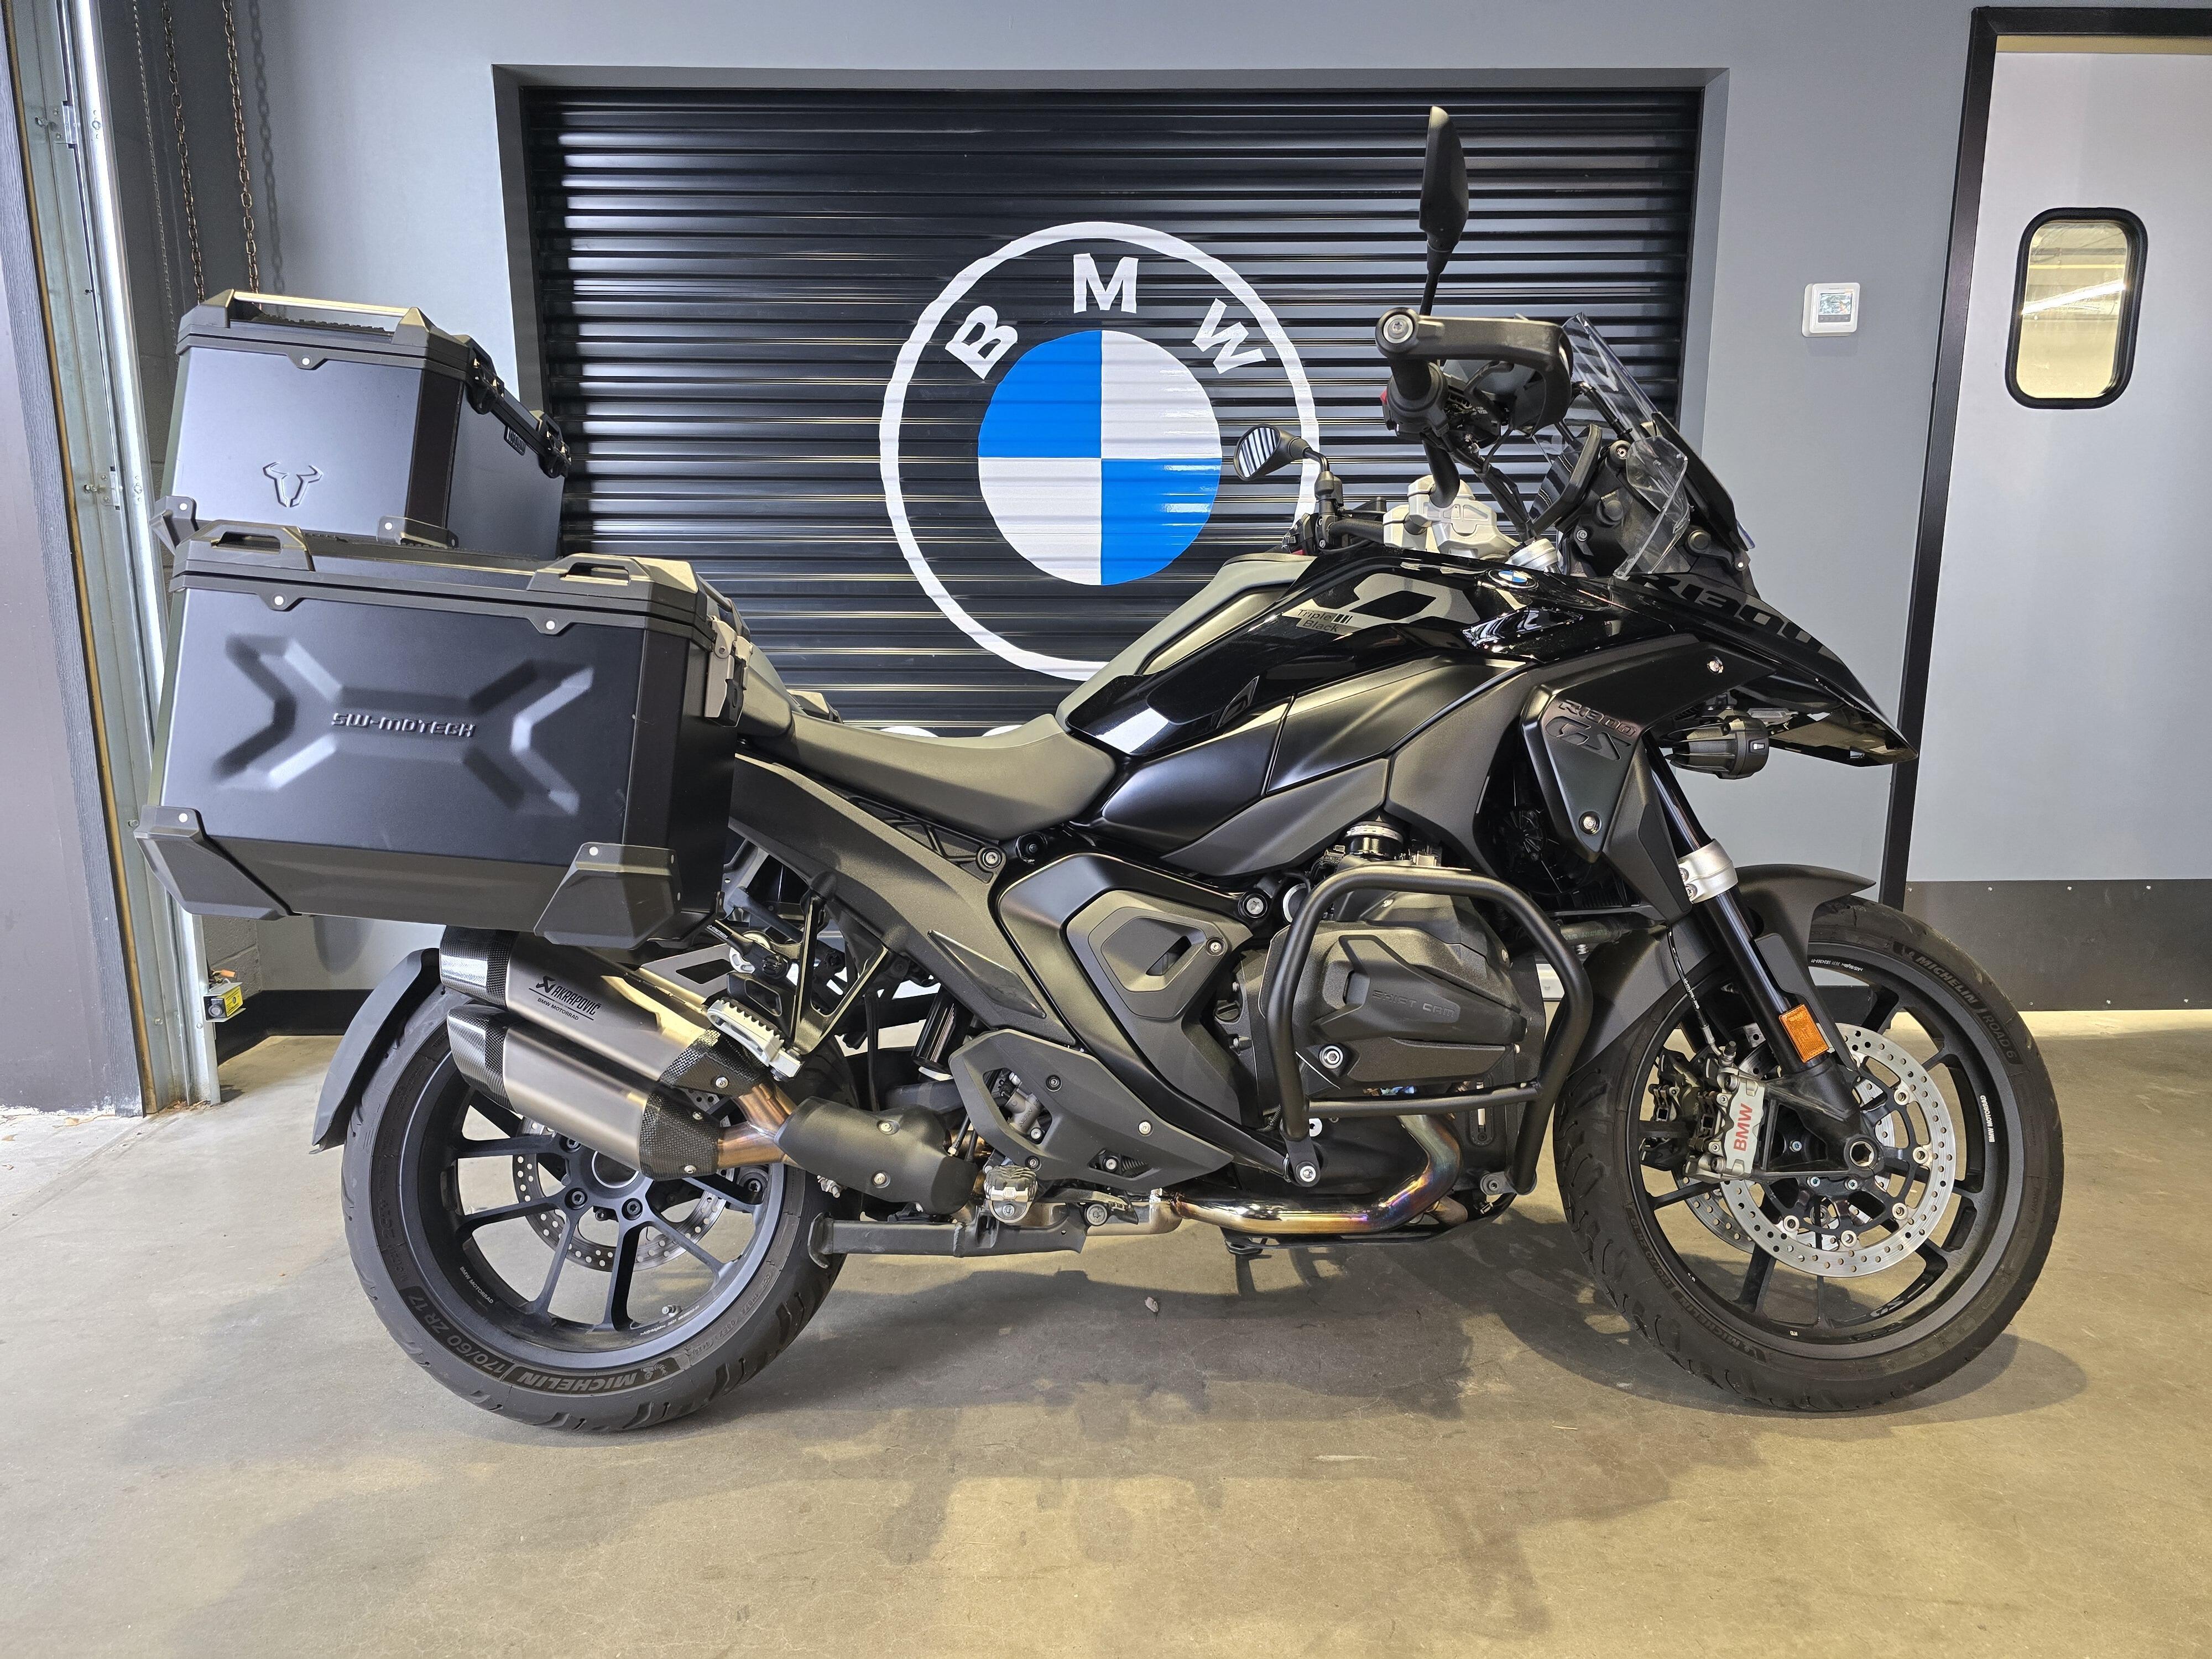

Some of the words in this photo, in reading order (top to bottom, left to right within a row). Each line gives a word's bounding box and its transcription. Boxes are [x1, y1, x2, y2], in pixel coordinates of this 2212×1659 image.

[945, 253, 1267, 380] BMW
[1297, 609, 1332, 620] Triple
[1302, 620, 1338, 632] Black
[331, 712, 476, 737] SW-MOTECH
[537, 998, 551, 1007] BMW
[551, 1004, 579, 1020] MOTORRAD
[1372, 989, 1417, 1008] SHIFT
[1422, 1002, 1455, 1018] CAM
[1916, 956, 1979, 1004] MICHELIN
[1982, 1015, 2010, 1047] ROAD
[2006, 1050, 2017, 1058] 6
[1980, 1095, 1993, 1127] MOTORRAD
[1733, 1103, 1753, 1151] BMW
[460, 1266, 471, 1279] BMW
[469, 1279, 494, 1303] MOTORRAD
[408, 1295, 429, 1311] 17
[424, 1312, 450, 1334] ZR
[1678, 1295, 1741, 1348] MICHELIN
[446, 1334, 507, 1373] 170/60
[517, 1371, 638, 1391] MICHELIN
